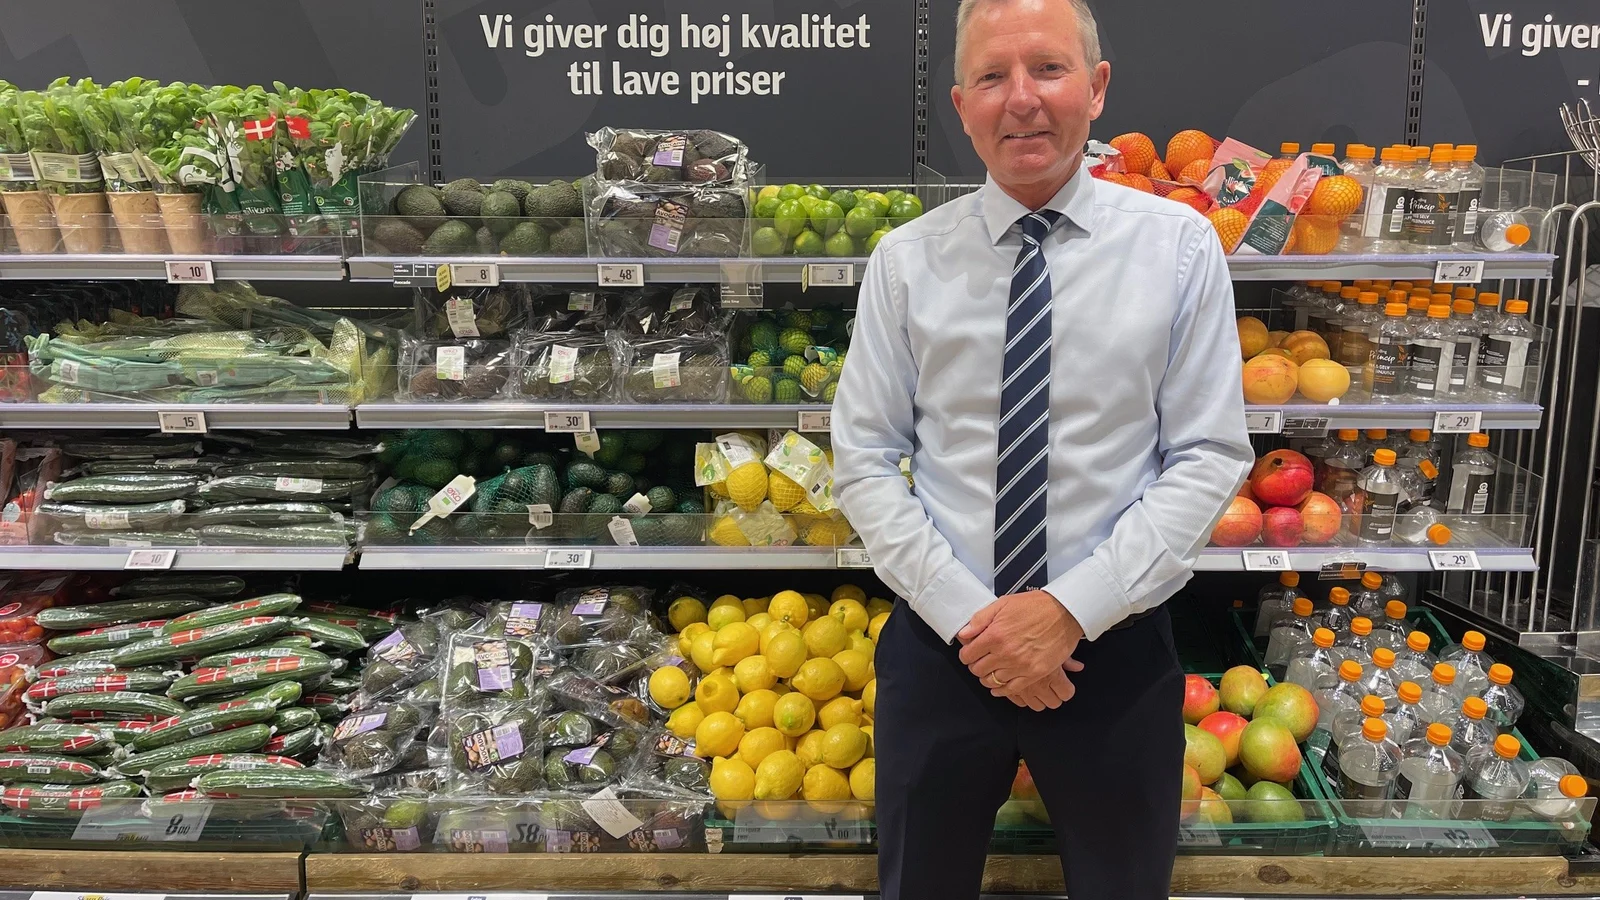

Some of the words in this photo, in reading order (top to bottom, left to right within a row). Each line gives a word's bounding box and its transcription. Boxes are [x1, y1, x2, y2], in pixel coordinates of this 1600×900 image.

[480, 14, 512, 47] Vi
[525, 14, 607, 56] giver
[613, 14, 669, 56] dig
[681, 14, 732, 56] høj
[742, 14, 870, 49] kvalitet
[1480, 14, 1512, 47] Vi
[1522, 14, 1600, 57] giver
[567, 62, 602, 95] til
[613, 62, 679, 96] lave
[691, 62, 785, 104] priser
[656, 210, 685, 223] AVOCADO
[190, 267, 202, 278] 10
[480, 269, 487, 280] 8
[619, 269, 632, 280] 48
[837, 269, 844, 280] 3
[1457, 266, 1471, 277] 29
[183, 416, 195, 428] 15
[566, 416, 579, 427] 30
[1264, 416, 1271, 428] 7
[1456, 416, 1470, 427] 29
[446, 487, 462, 503] ØKO
[566, 553, 580, 564] 30
[1266, 555, 1279, 566] 16
[1452, 555, 1466, 565] 29
[477, 651, 508, 661] AVOCADO
[476, 733, 491, 765] AVOCADO
